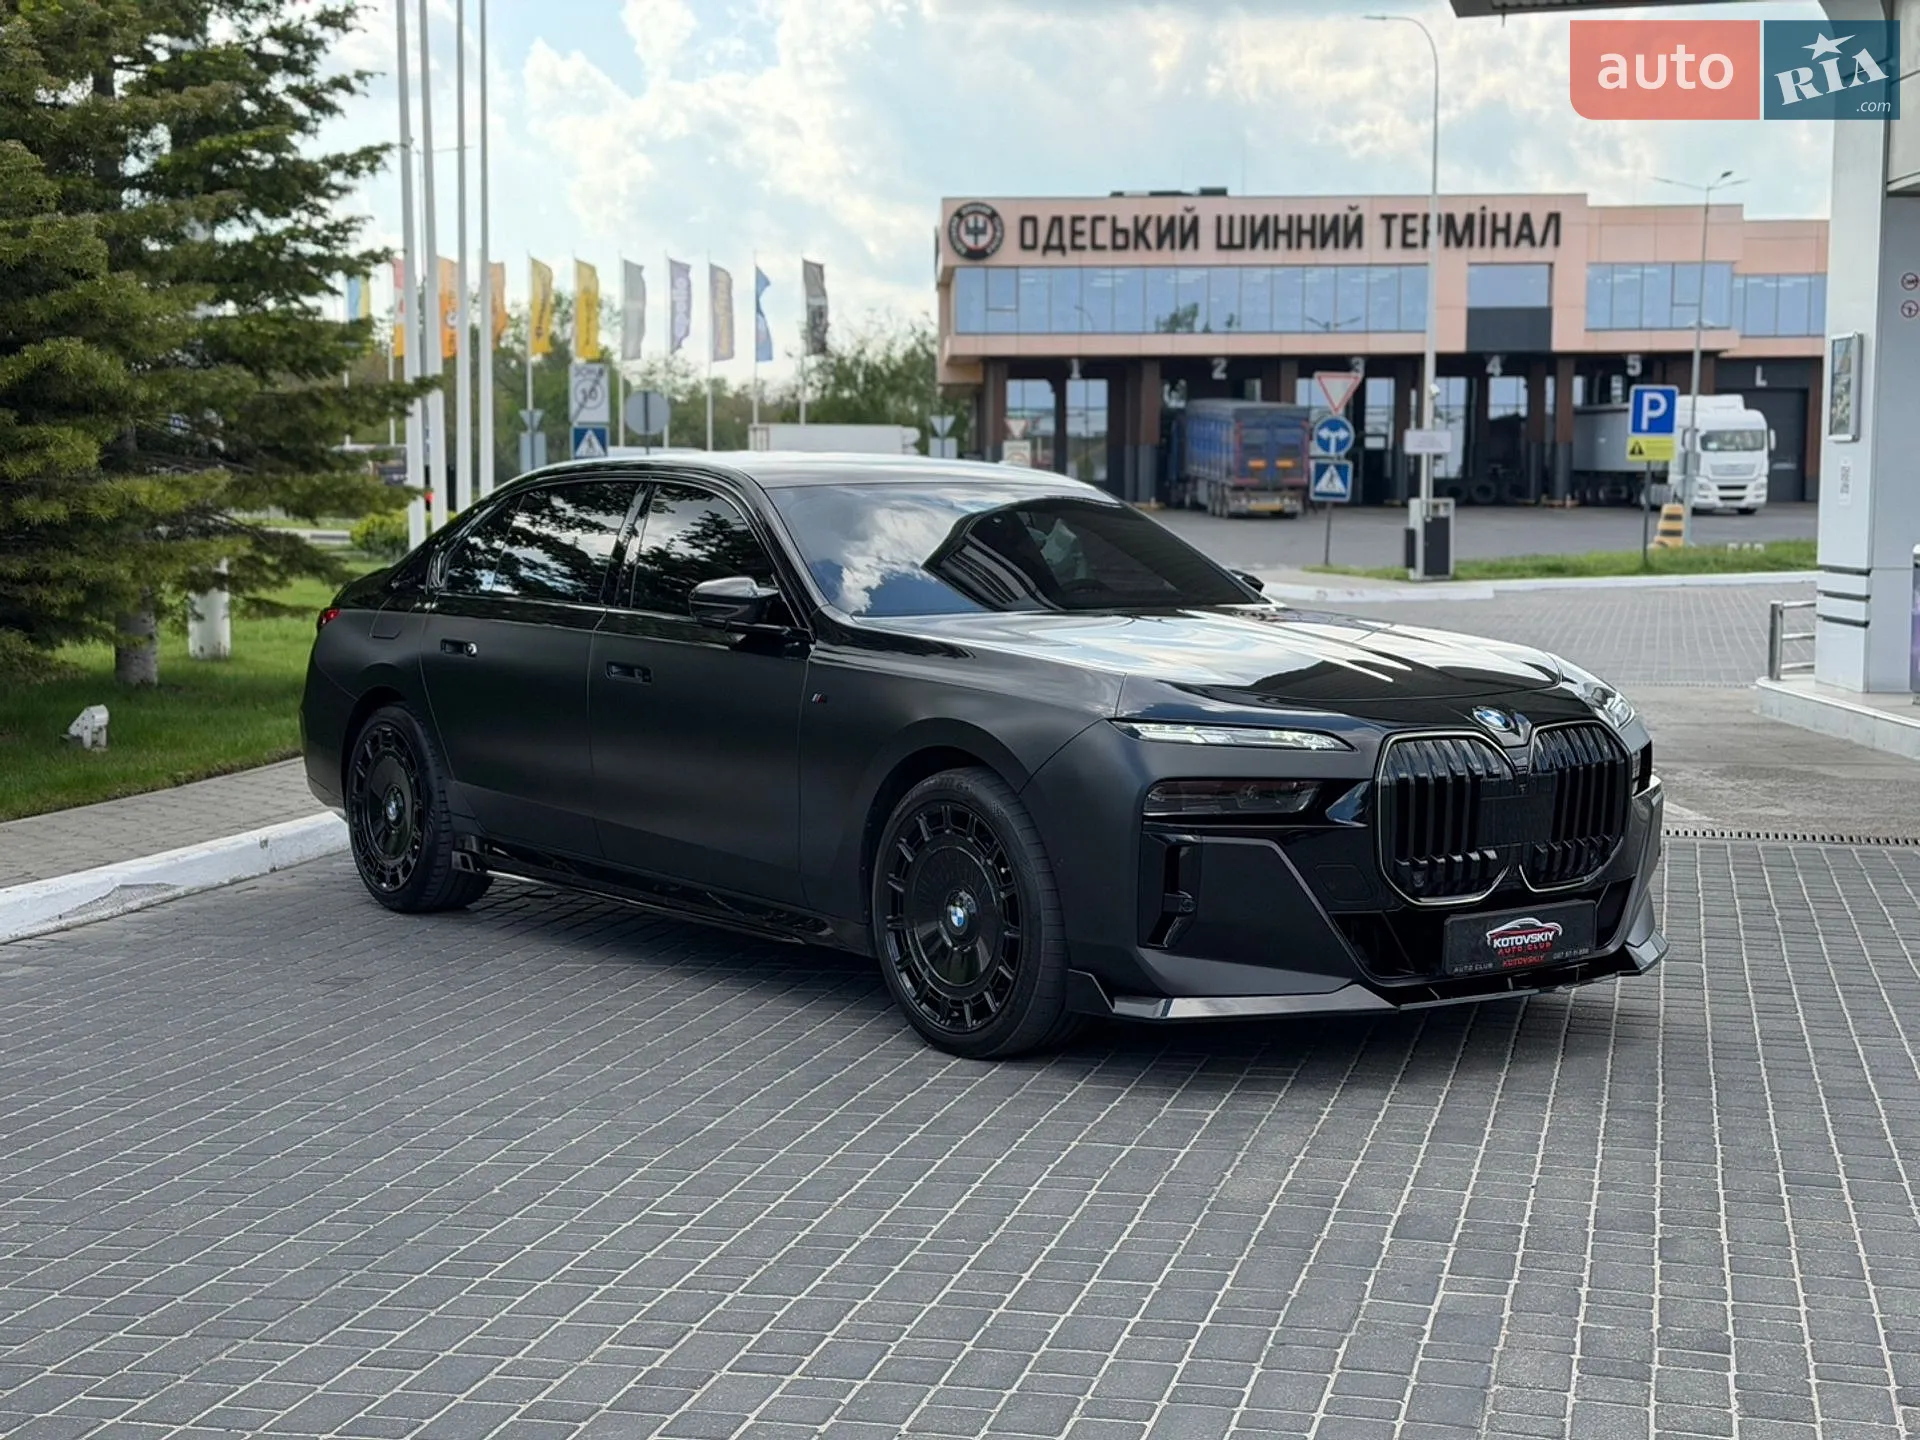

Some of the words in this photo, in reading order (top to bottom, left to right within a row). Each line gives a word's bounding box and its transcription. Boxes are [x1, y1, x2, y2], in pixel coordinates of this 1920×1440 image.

[1019, 206, 1199, 257] ОДЕСЬКИЙ
[1215, 206, 1364, 251] ШИННИЙ
[1212, 357, 1227, 379] 2
[1486, 355, 1502, 376] 4
[1626, 354, 1642, 376] 5
[1755, 365, 1767, 387] L
[1641, 391, 1668, 431] P
[1493, 931, 1555, 948] KOTOVSKIY
